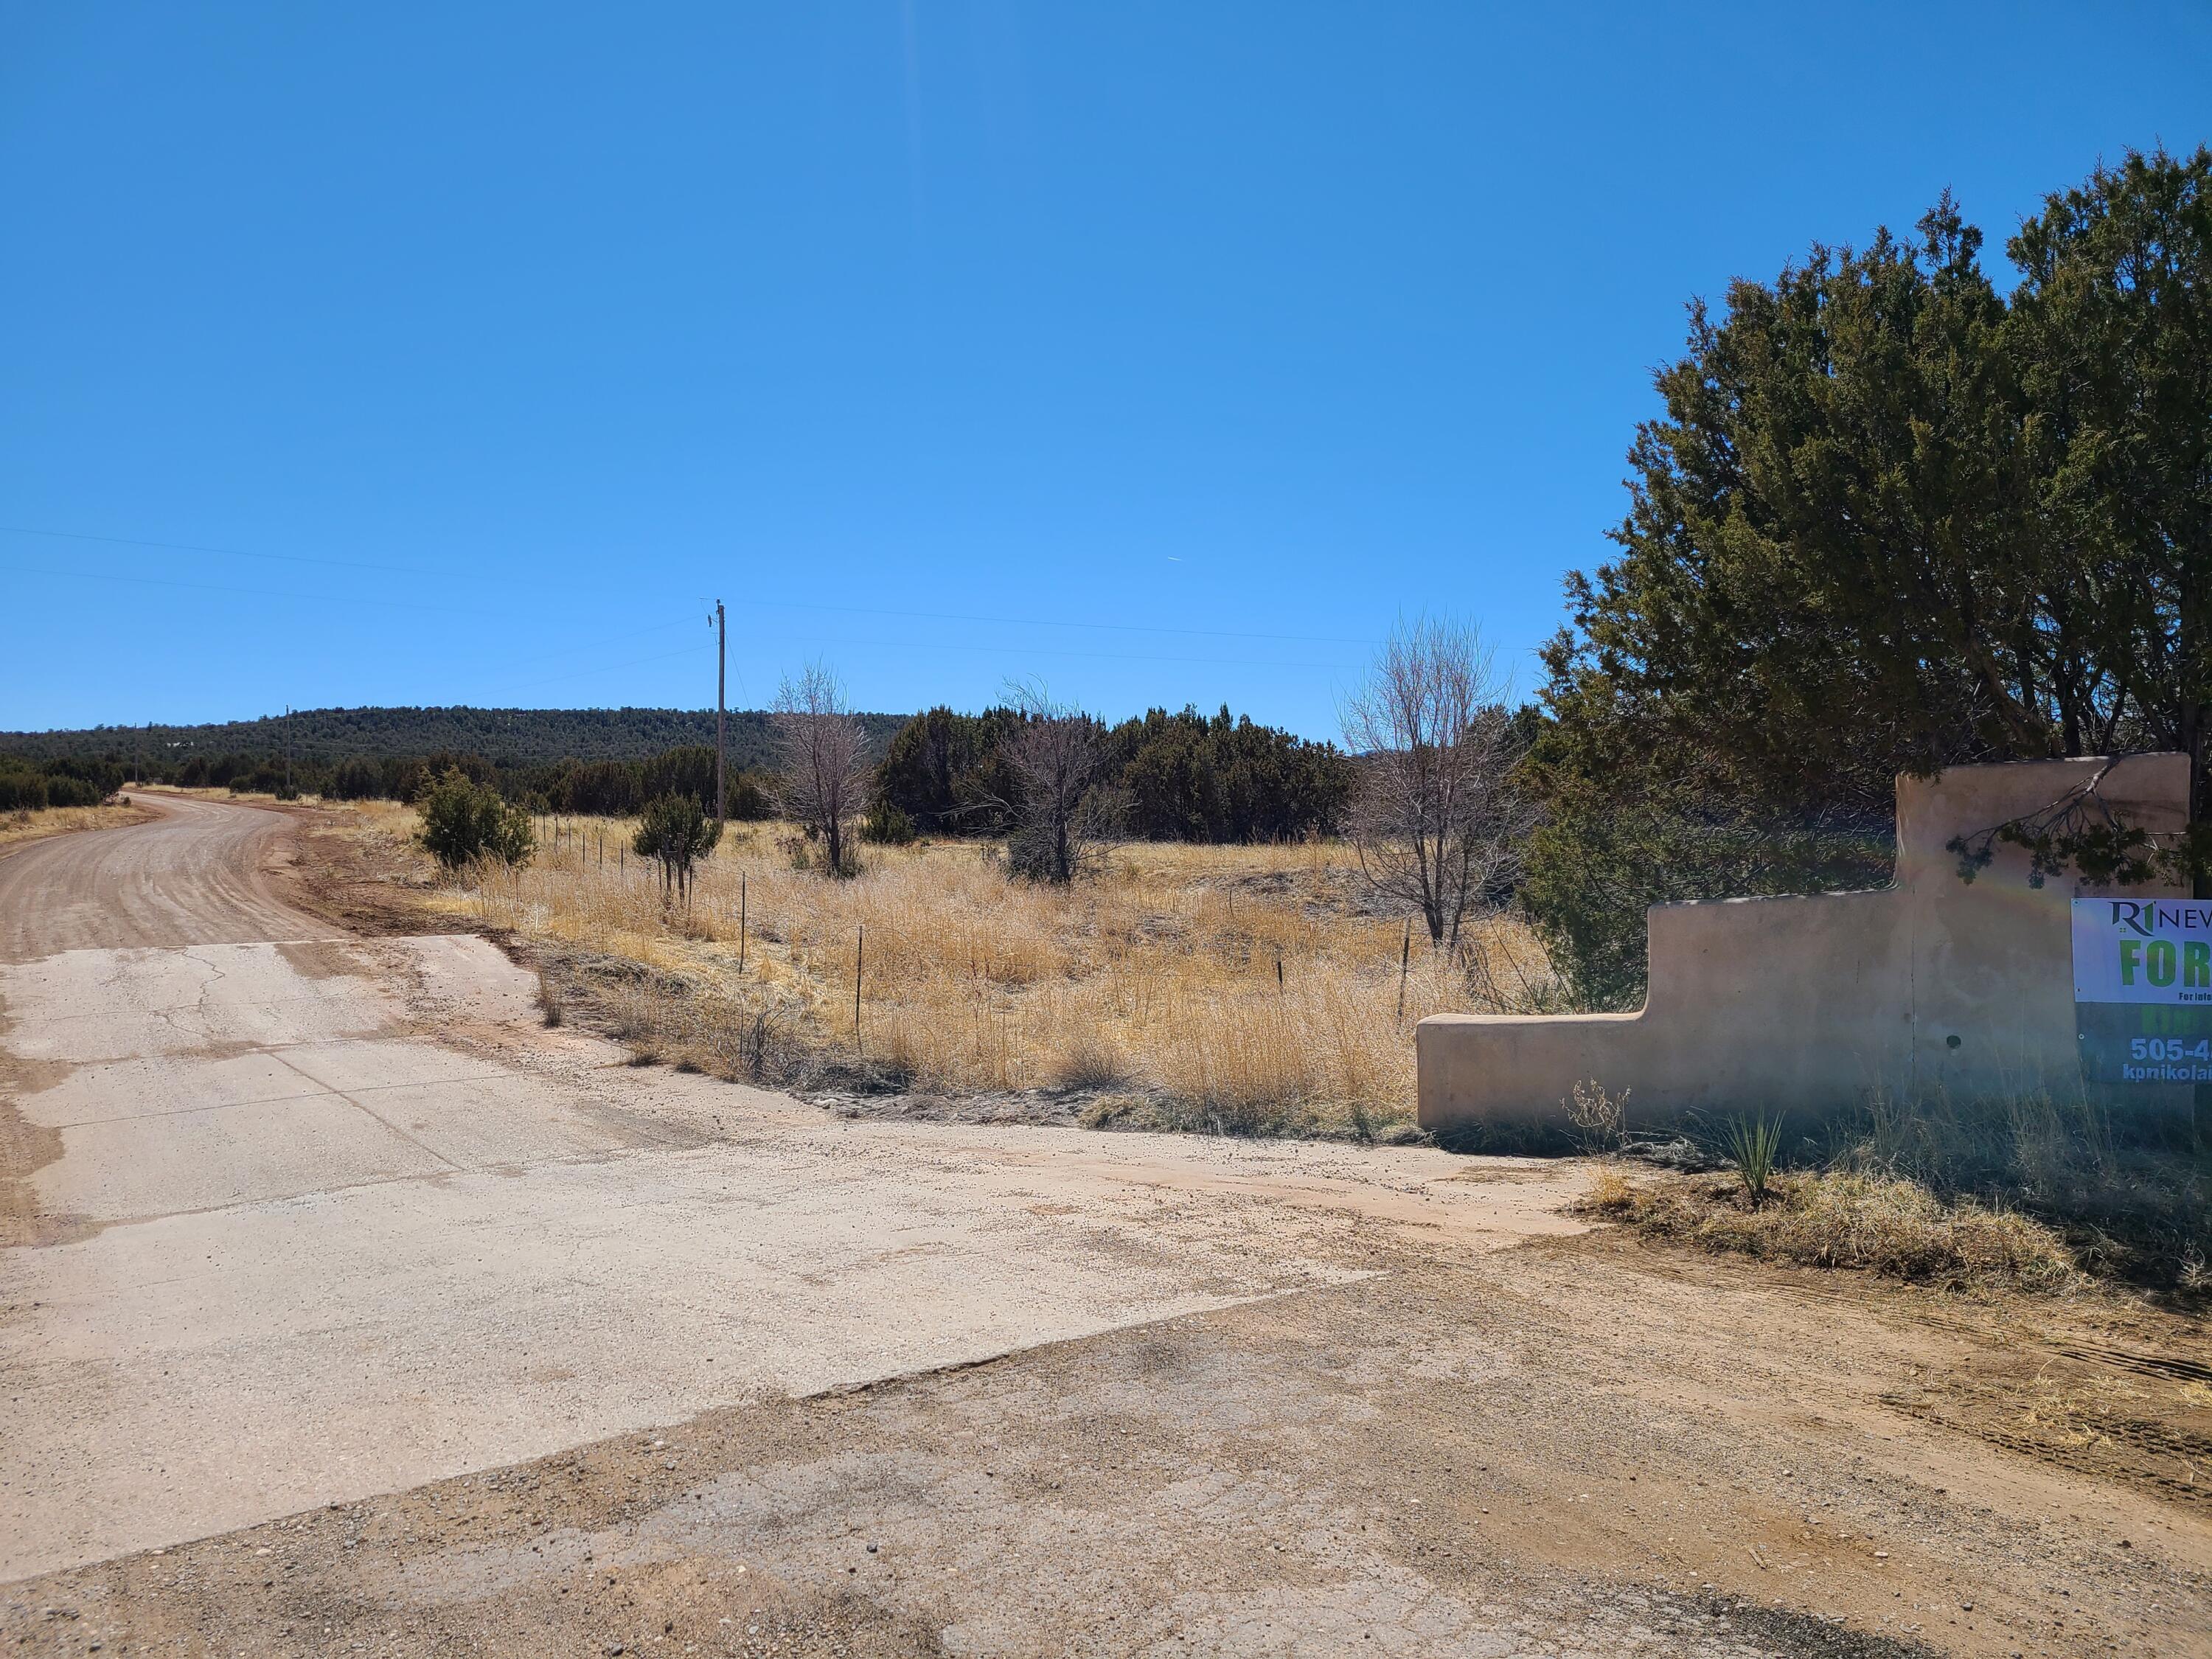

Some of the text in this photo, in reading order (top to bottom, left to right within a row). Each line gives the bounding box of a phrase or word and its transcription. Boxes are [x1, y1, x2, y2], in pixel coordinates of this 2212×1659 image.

[2120, 940, 2211, 987] FOR
[2179, 992, 2193, 1001] For
[2131, 1039, 2212, 1061] 505-4
